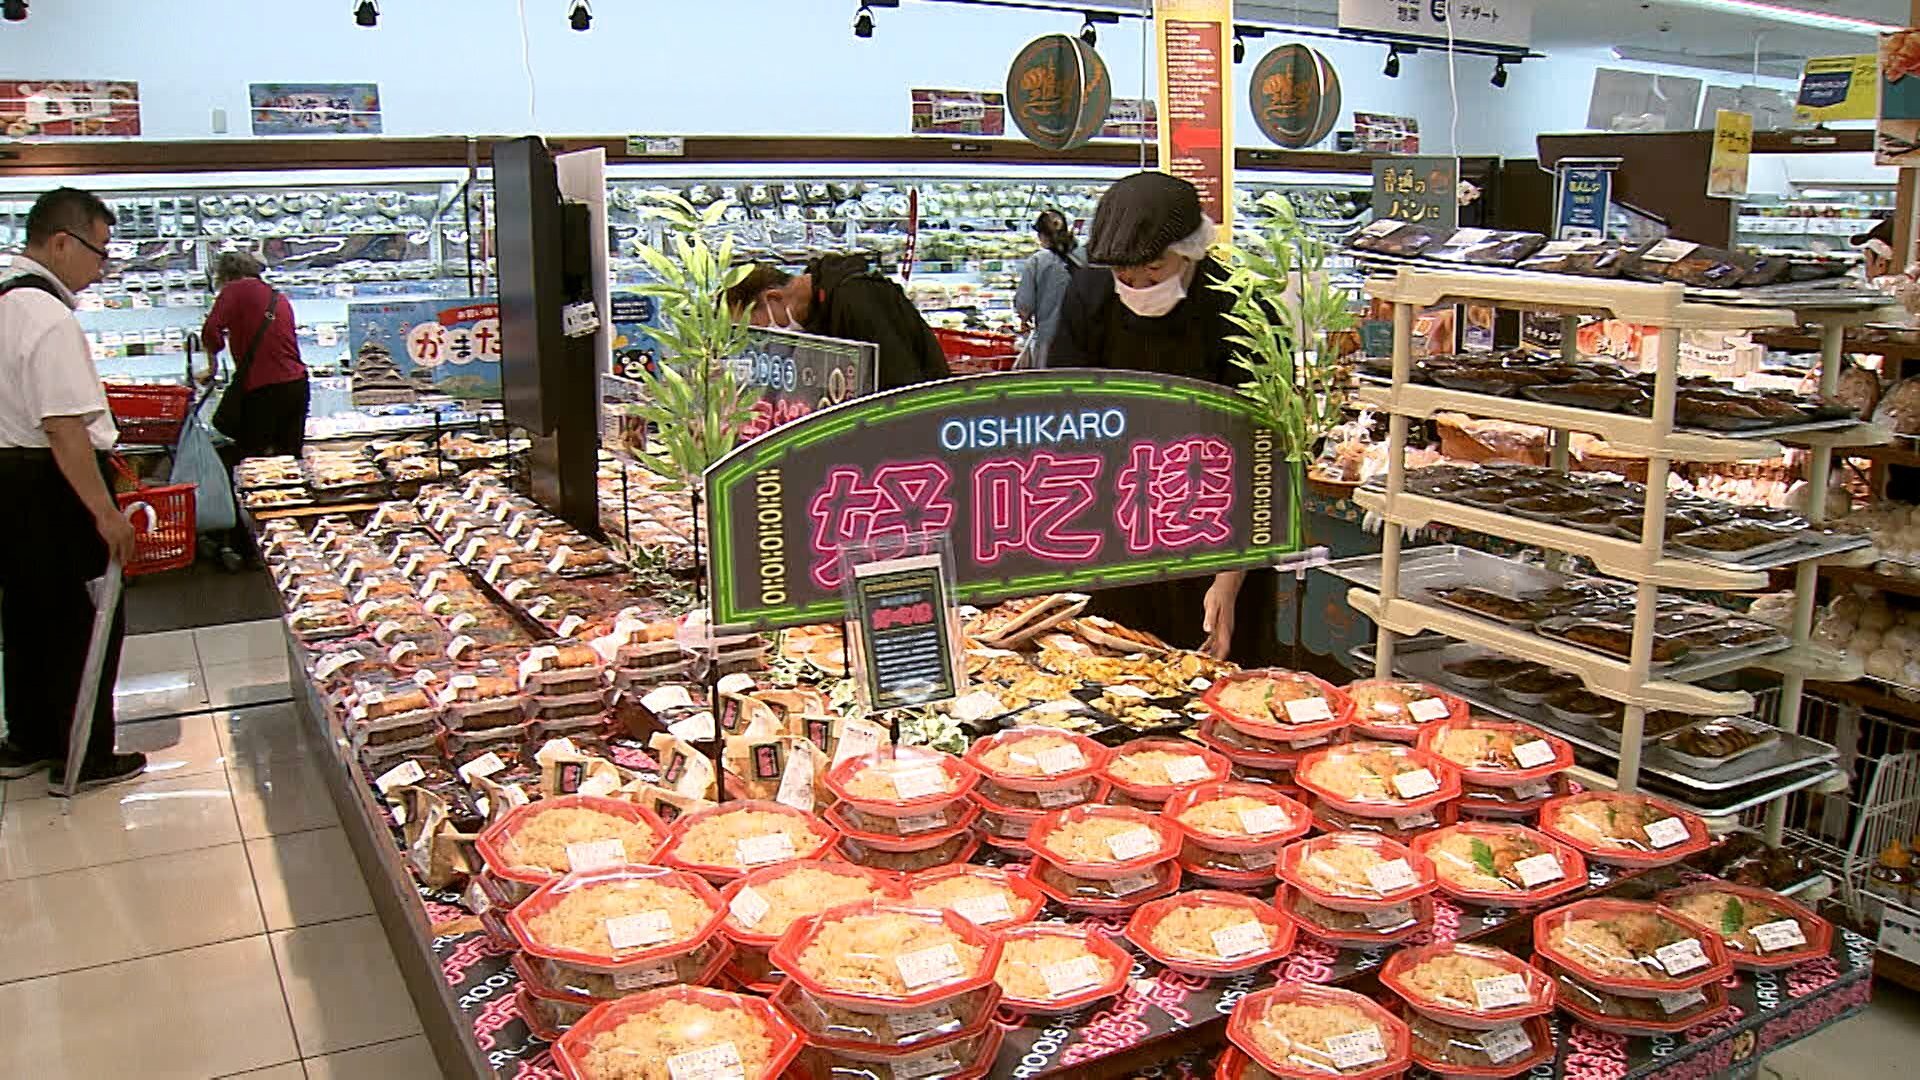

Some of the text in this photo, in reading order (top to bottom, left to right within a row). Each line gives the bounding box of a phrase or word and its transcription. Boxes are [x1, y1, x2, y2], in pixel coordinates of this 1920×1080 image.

[940, 408, 1126, 452] OISHIKARO
[811, 440, 1234, 588] 好吃楼
